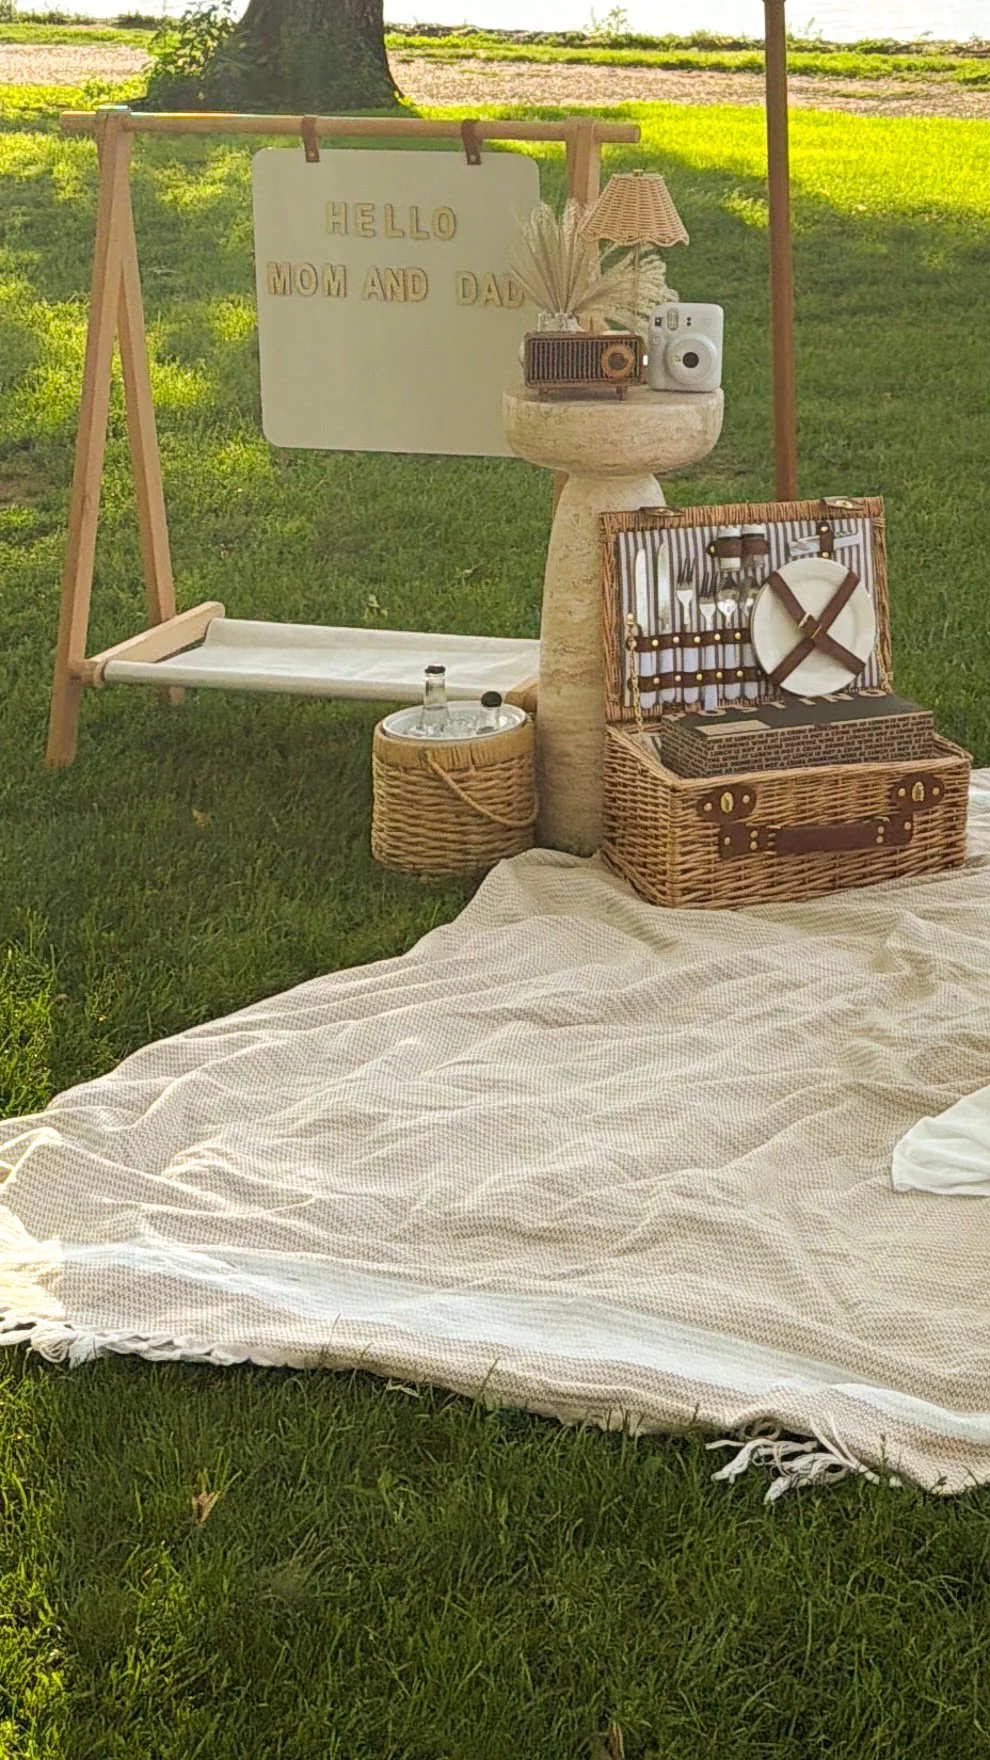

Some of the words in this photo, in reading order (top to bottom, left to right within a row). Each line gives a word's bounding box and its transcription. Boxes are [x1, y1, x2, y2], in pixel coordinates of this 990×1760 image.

[325, 201, 456, 240] HELLO
[267, 261, 347, 298] MOM
[362, 265, 428, 302] AND
[456, 270, 525, 309] DAD
